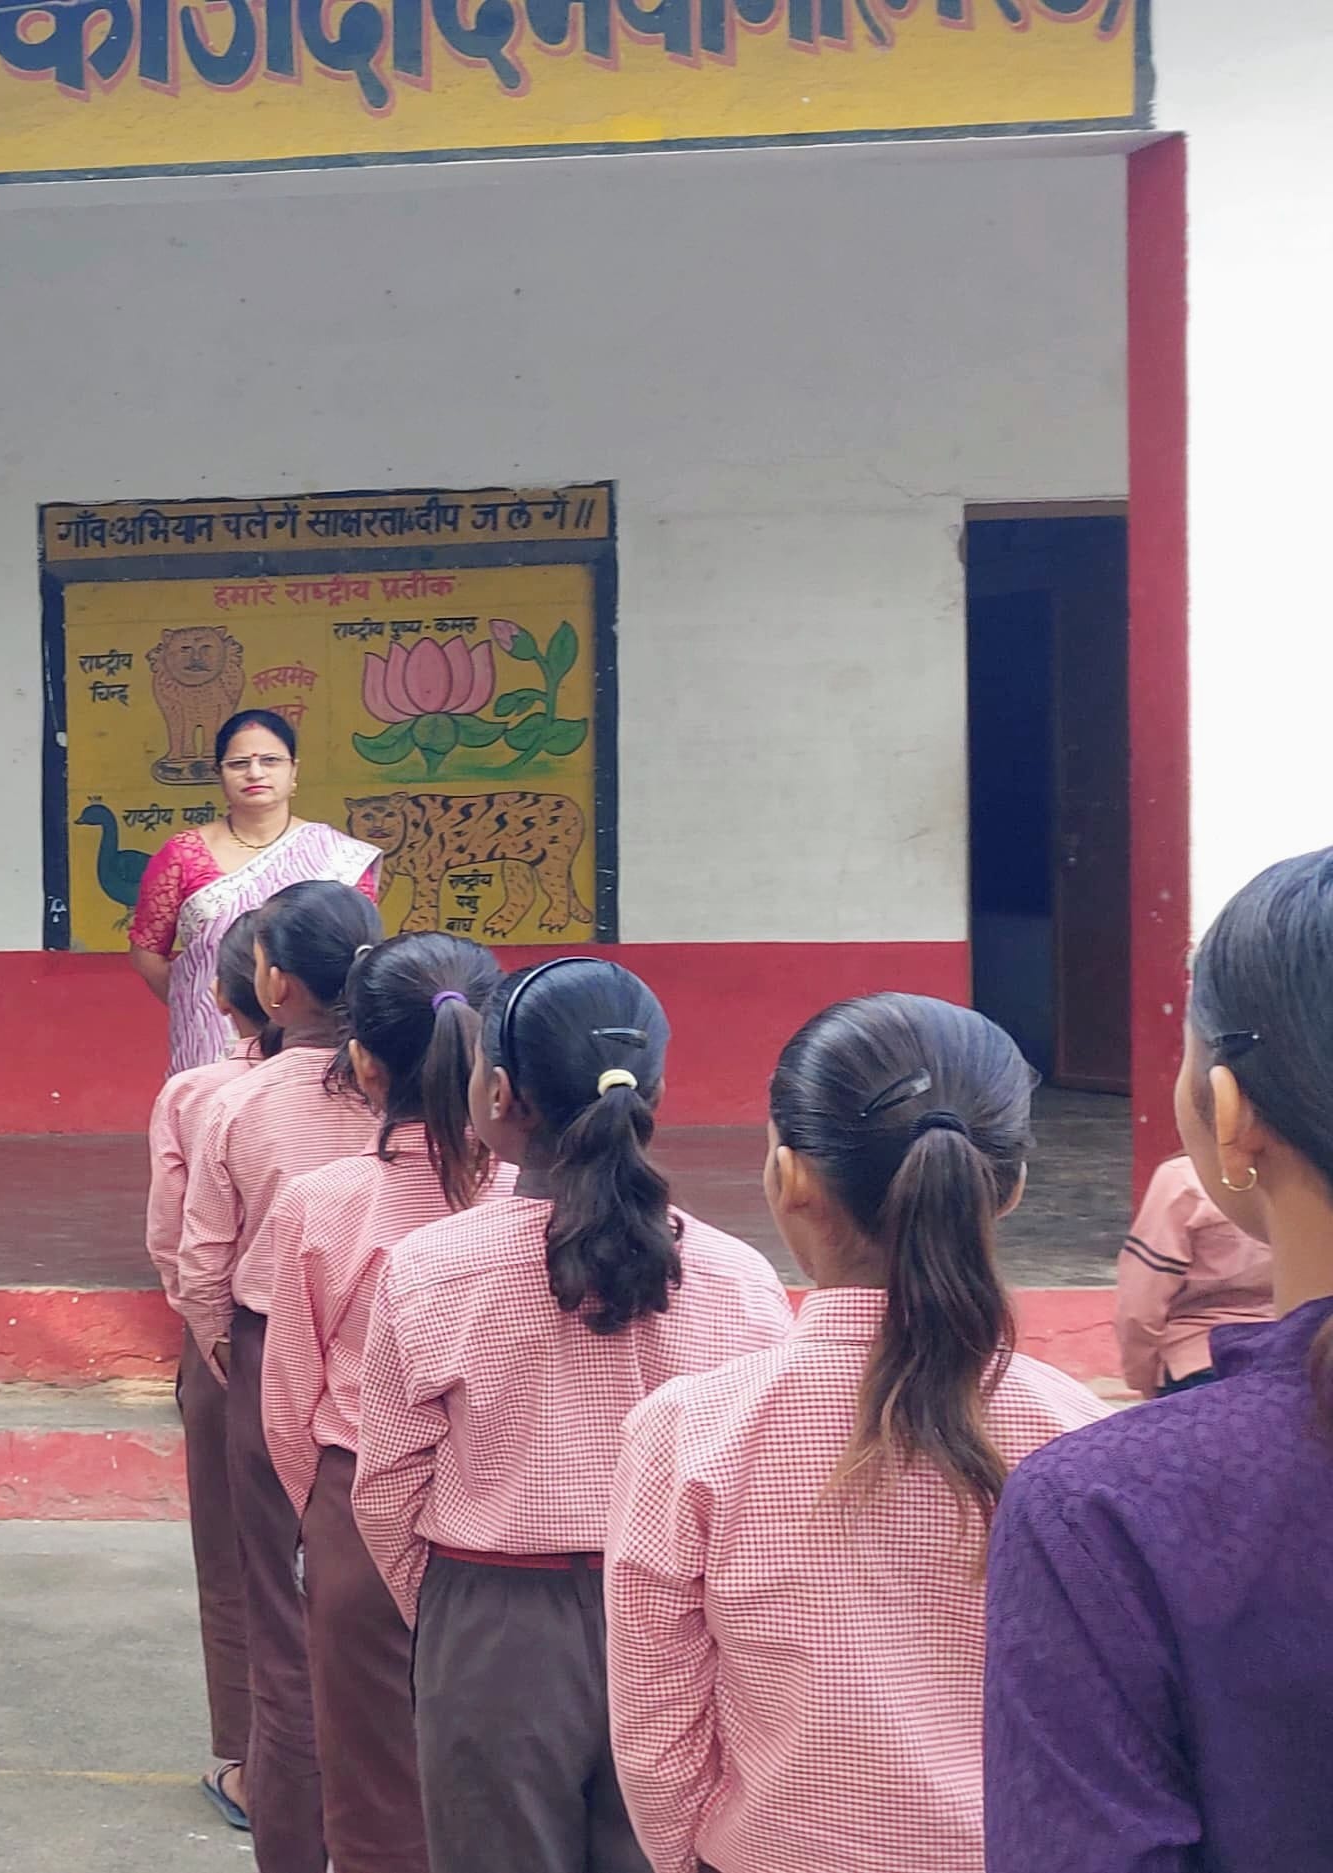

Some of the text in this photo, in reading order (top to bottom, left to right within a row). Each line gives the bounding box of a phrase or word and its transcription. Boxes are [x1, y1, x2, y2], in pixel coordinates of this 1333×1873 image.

[213, 571, 456, 610] हमारे राष्ट्रीय प्रतीक
[333, 617, 385, 641] राष्ट्रीय
[79, 649, 133, 676] राष्ट्रीय
[251, 660, 319, 695] सत्यमेव
[89, 681, 130, 706] चिन्ह
[123, 803, 174, 832] राष्ट्रीय
